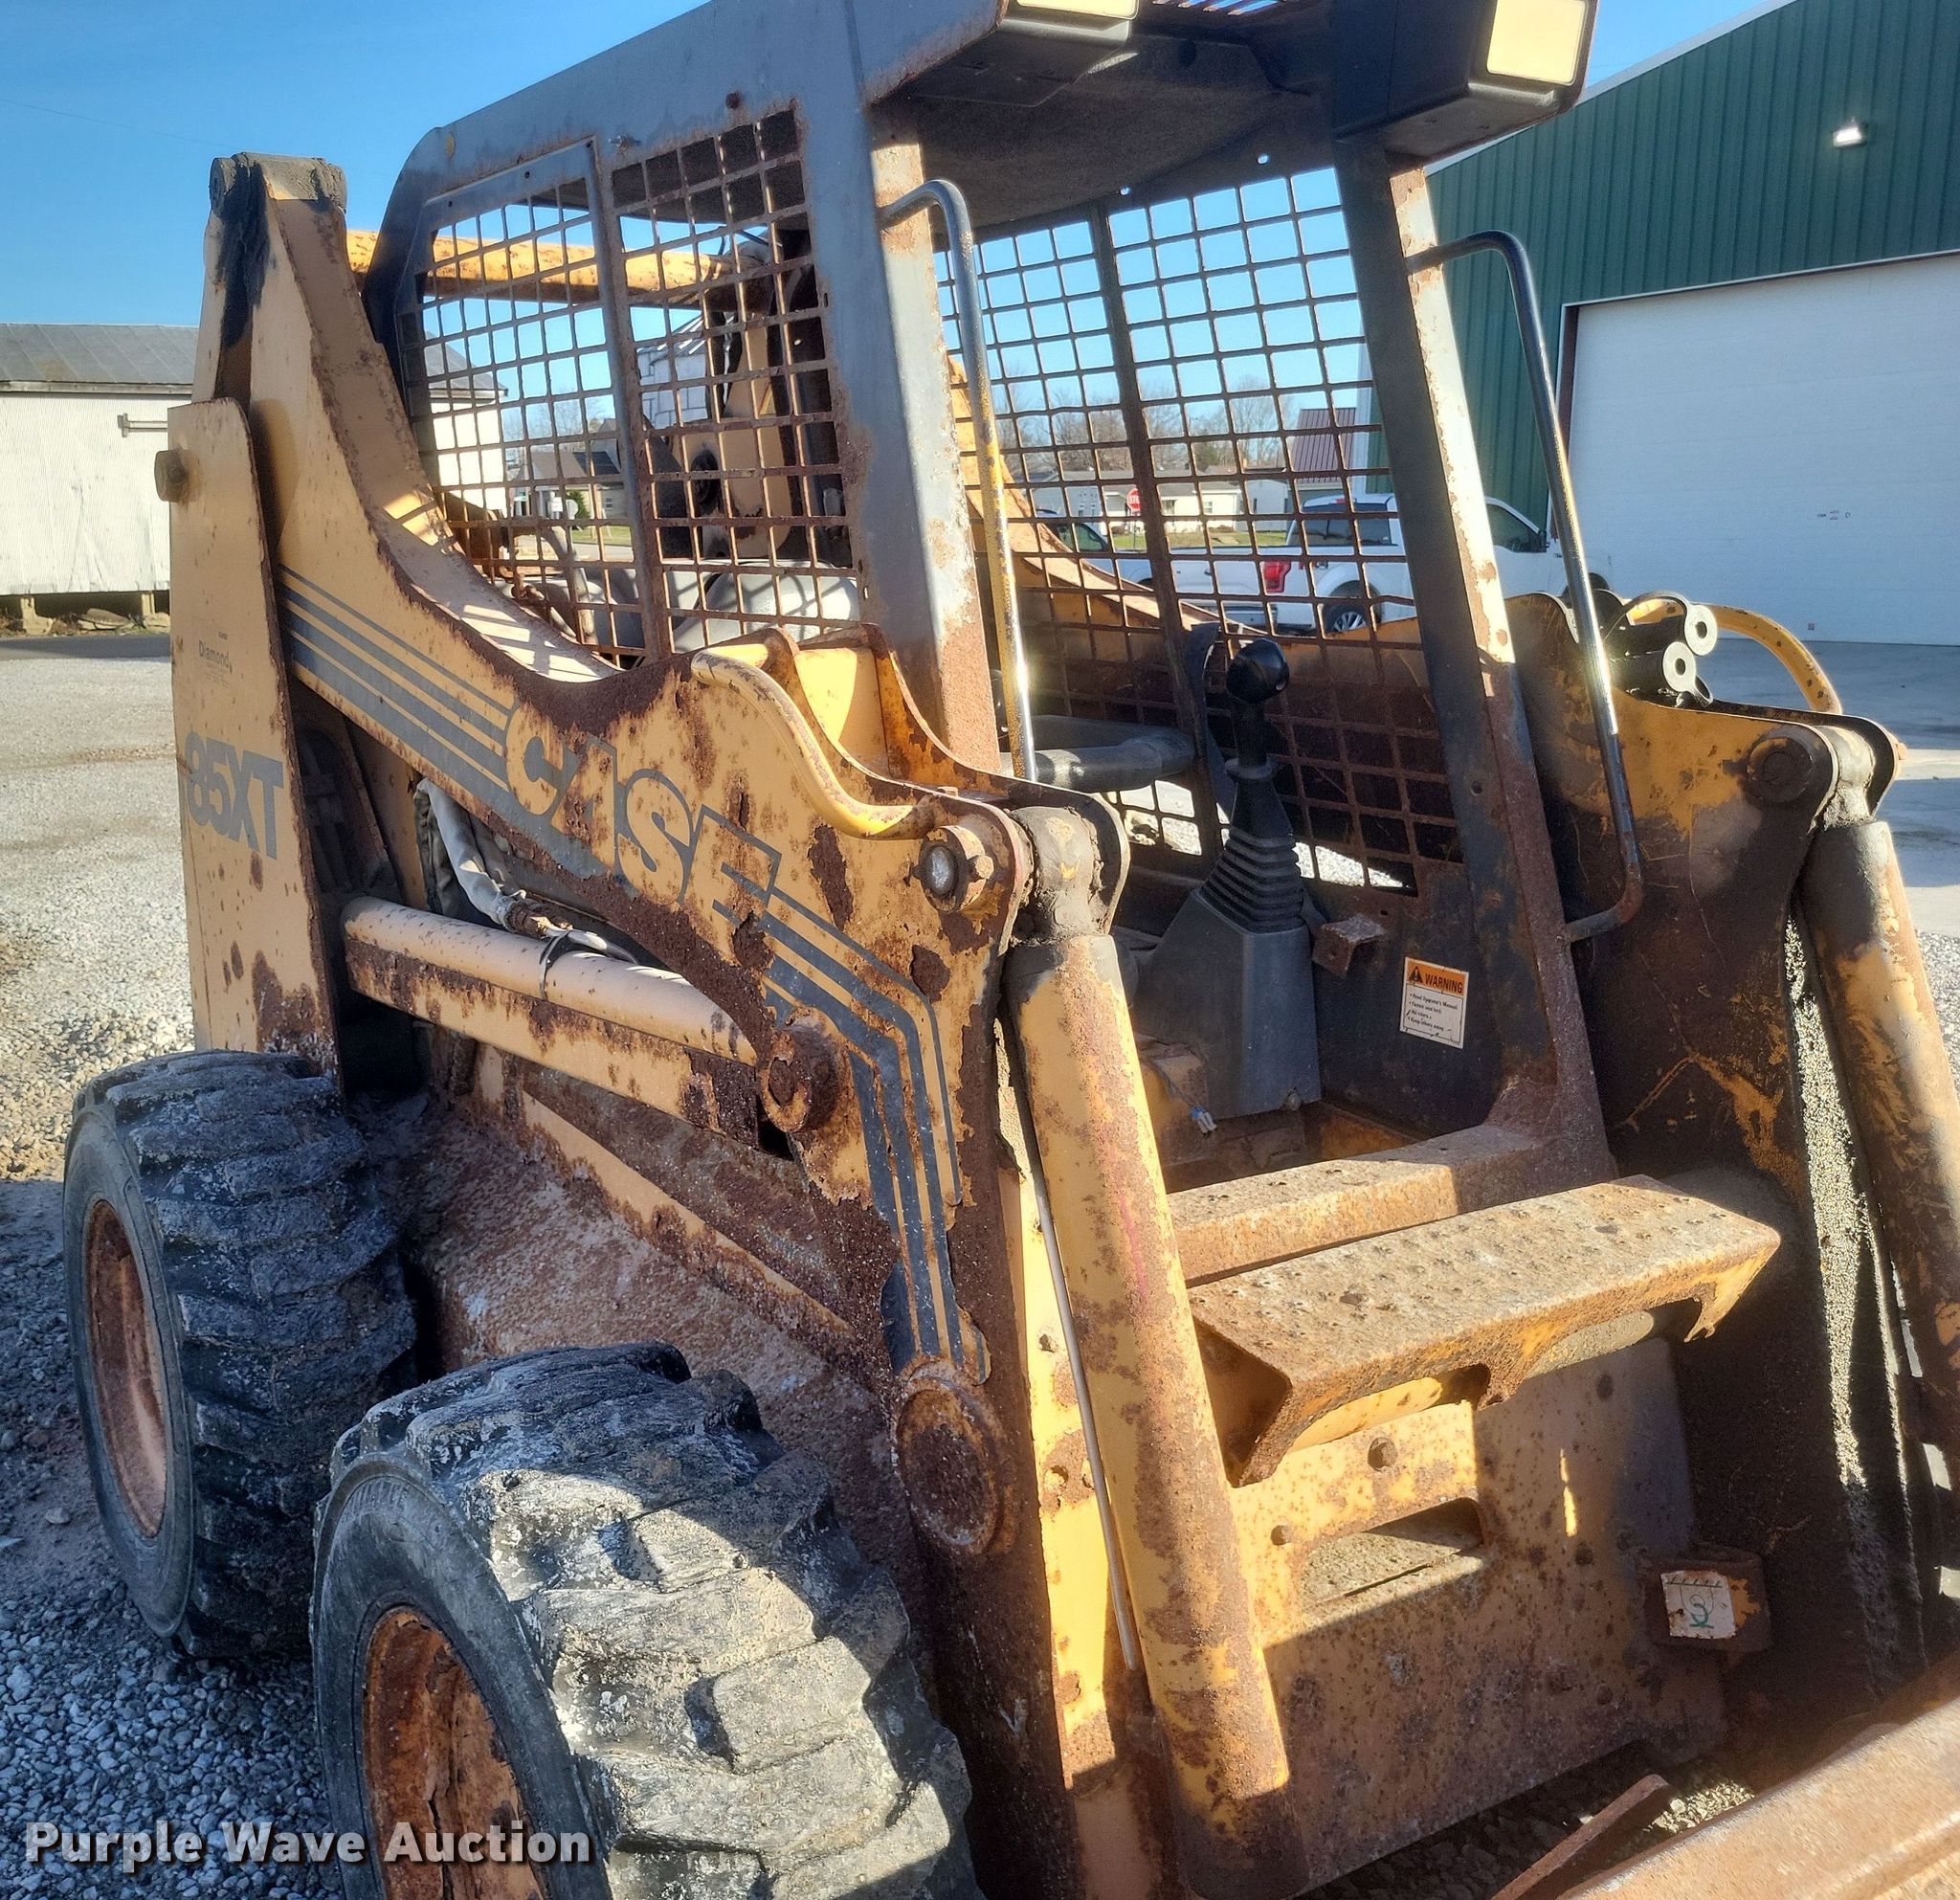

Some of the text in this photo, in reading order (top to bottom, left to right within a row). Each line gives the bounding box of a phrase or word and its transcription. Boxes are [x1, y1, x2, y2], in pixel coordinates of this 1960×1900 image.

[199, 640, 230, 668] Diamond
[185, 730, 284, 861] 85XT
[505, 702, 781, 963] CASE
[1425, 973, 1462, 994] WARNING
